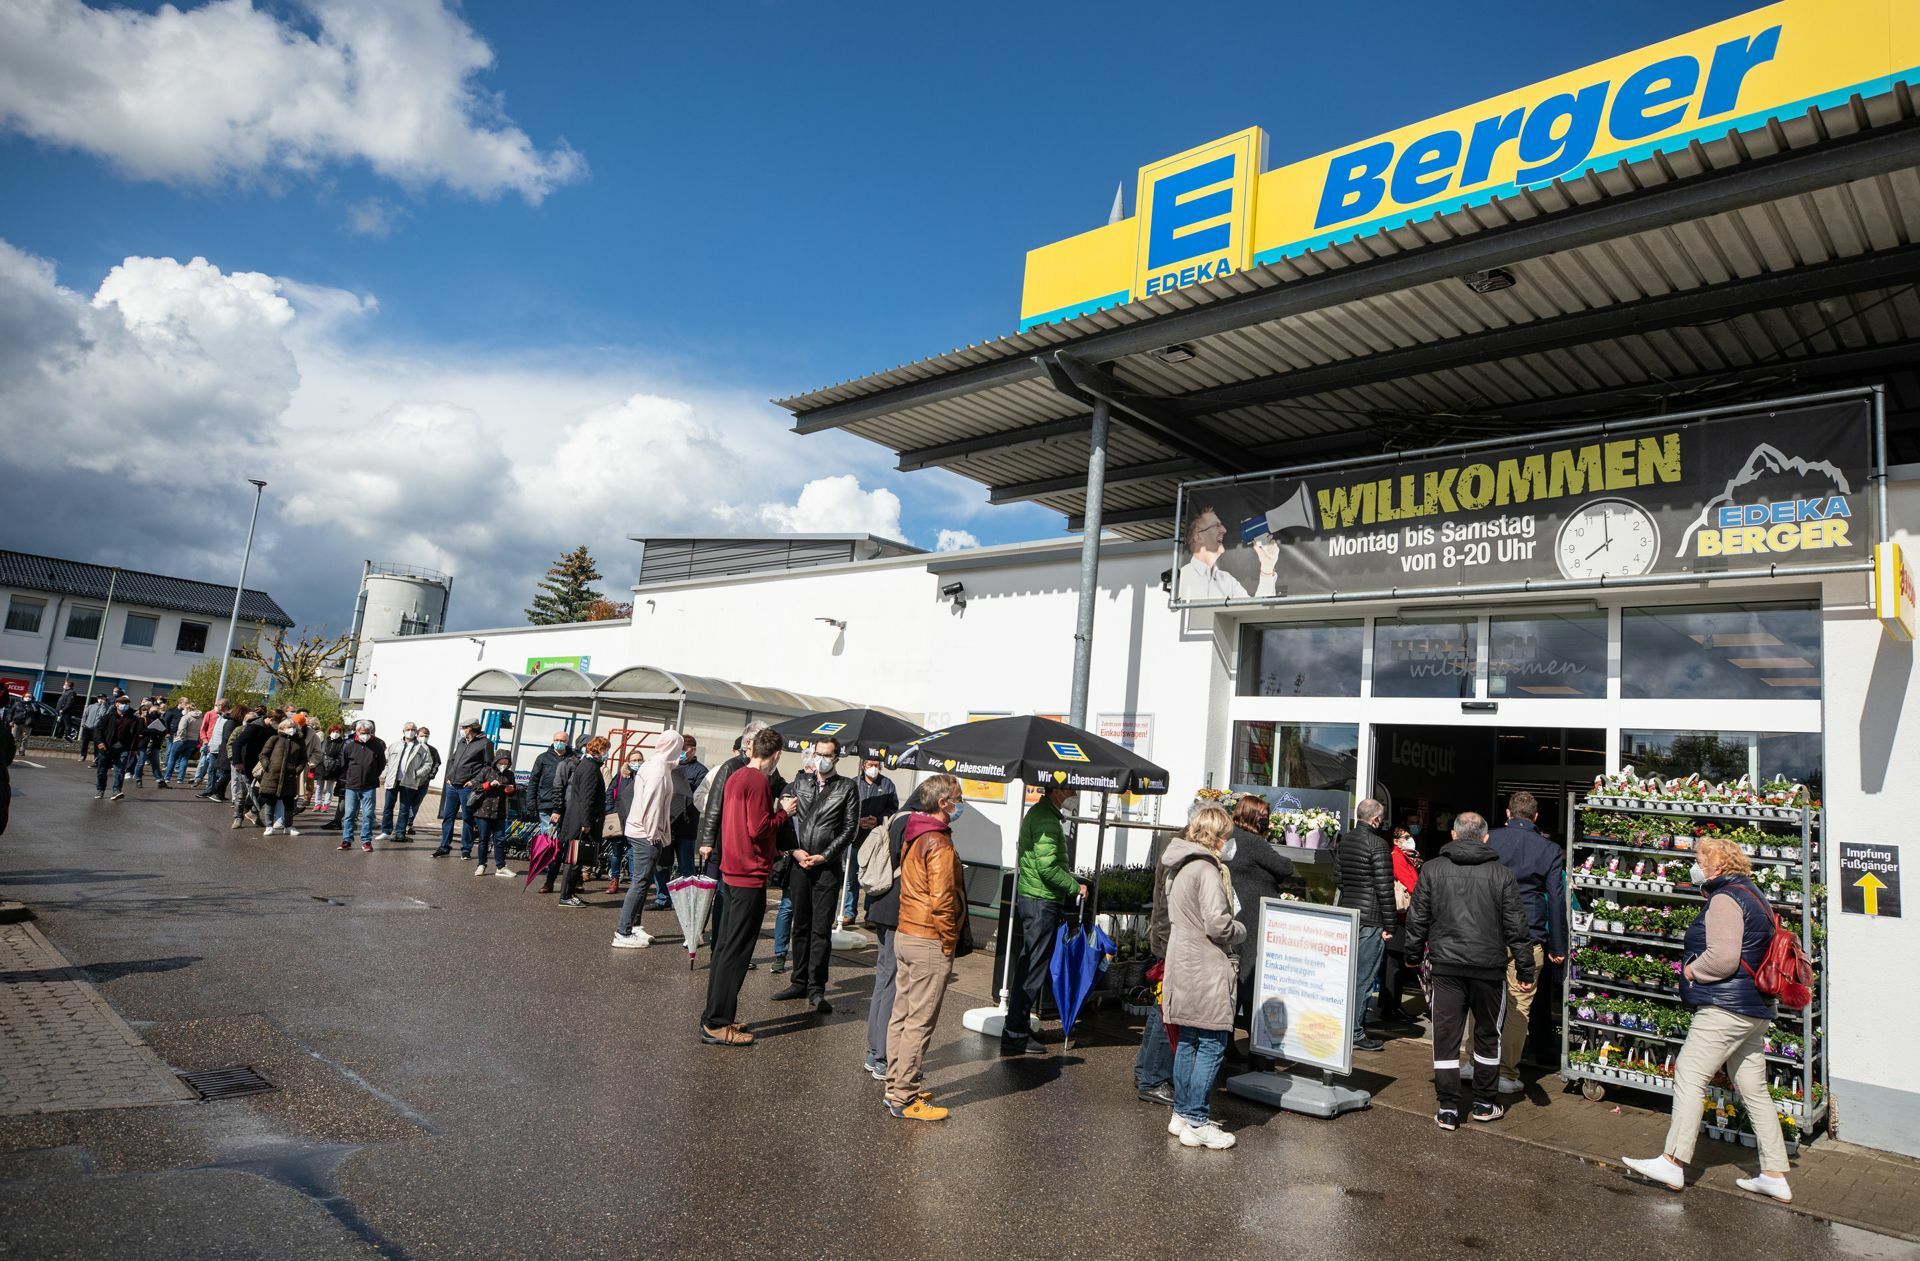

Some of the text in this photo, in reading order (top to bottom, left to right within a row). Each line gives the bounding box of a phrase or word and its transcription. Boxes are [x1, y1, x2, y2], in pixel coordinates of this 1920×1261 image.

[1313, 25, 1783, 230] Berger
[1148, 153, 1236, 271] E
[1146, 257, 1231, 297] EDEKA
[1317, 432, 1682, 530] WILLKOMMEN
[1719, 495, 1852, 528] EDEKA
[1585, 516, 1593, 526] 11
[1633, 521, 1640, 531] 2
[1328, 514, 1536, 557] Montag bis Samstag
[1574, 528, 1585, 537] 10
[1698, 519, 1853, 557] BERGER
[1568, 545, 1576, 554] 9
[1640, 537, 1647, 547] 3
[1401, 538, 1537, 573] von 8-20 Uhr
[1633, 553, 1640, 561] 4
[1574, 559, 1581, 568] 8
[1622, 566, 1629, 575] 5
[1586, 569, 1593, 577] 7
[1390, 634, 1536, 660] HERZLCH
[788, 740, 800, 749] Wir
[868, 748, 879, 757] Wir
[1392, 732, 1456, 777] Leergut
[928, 757, 944, 768] Wir
[955, 761, 1007, 777] Lebensmittel.
[1037, 770, 1119, 789] Wir Lebensmittel.
[1846, 848, 1891, 862] Impfung
[1841, 858, 1899, 874] Fußgänger
[1336, 931, 1348, 940] mit
[1266, 931, 1348, 957] Einkaufswagen!
[1265, 951, 1283, 961] wenn
